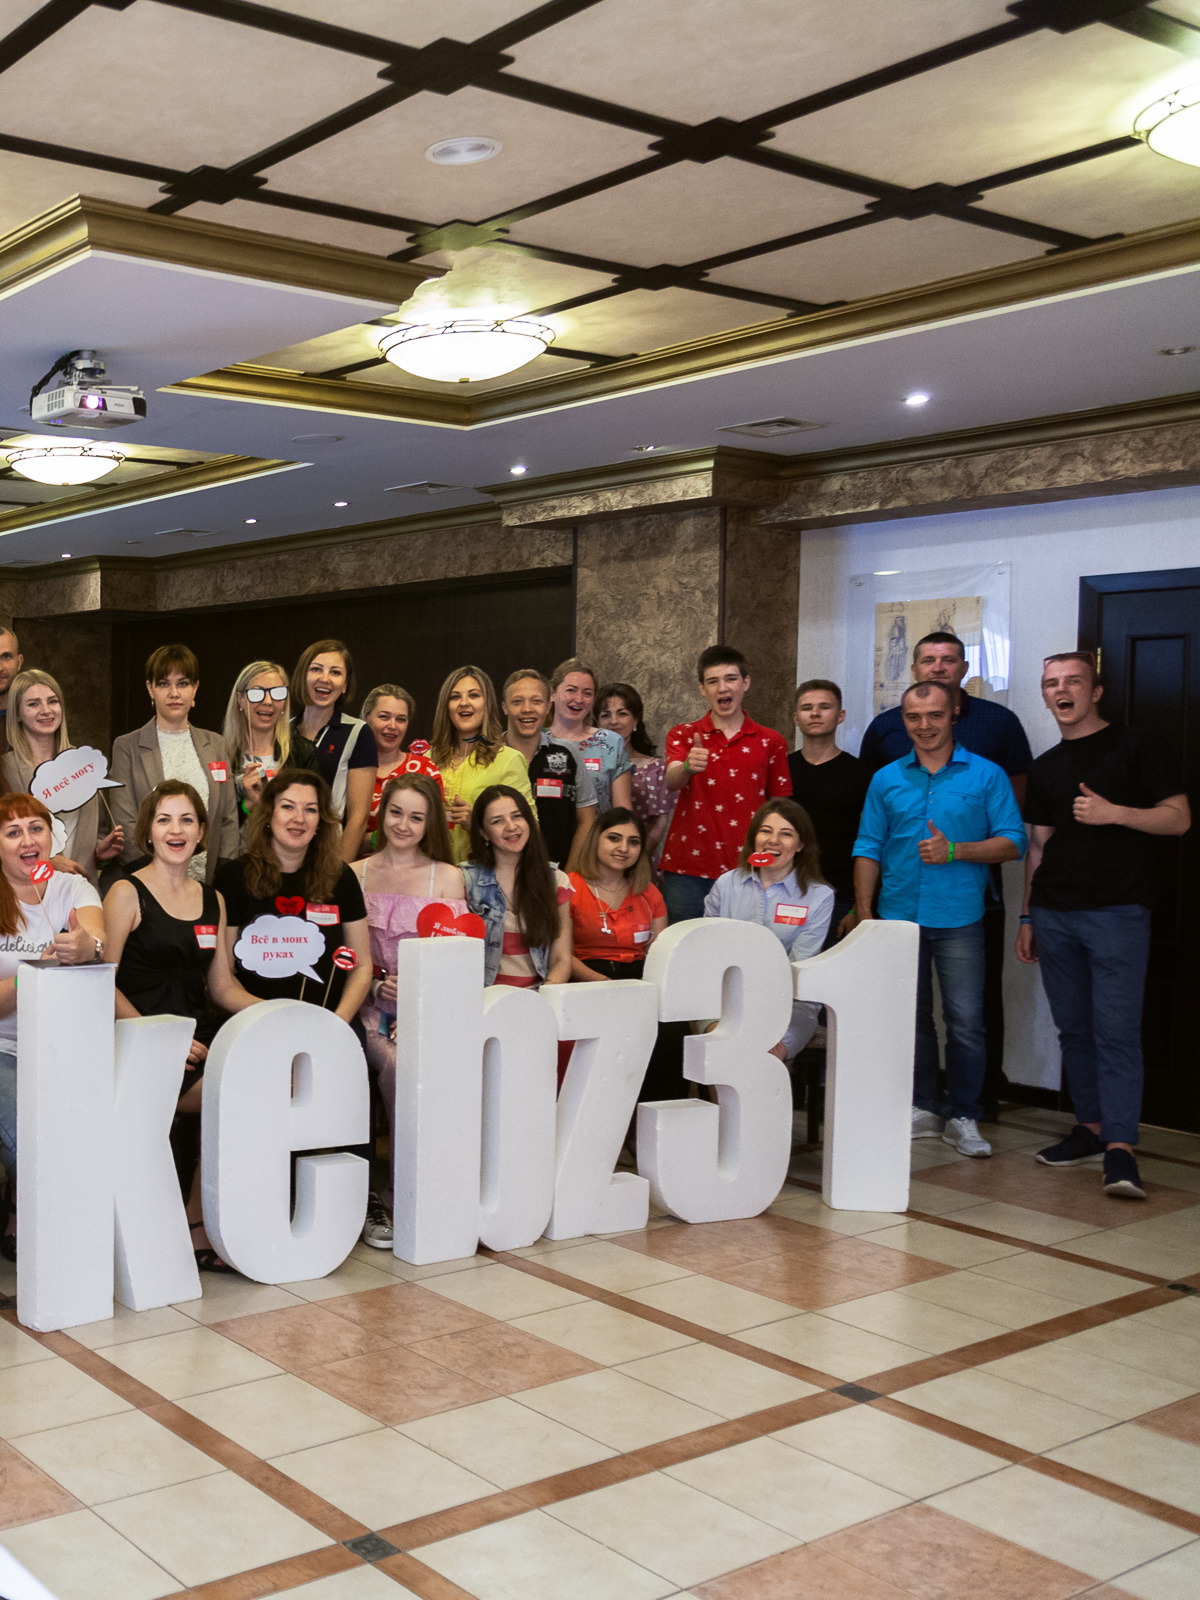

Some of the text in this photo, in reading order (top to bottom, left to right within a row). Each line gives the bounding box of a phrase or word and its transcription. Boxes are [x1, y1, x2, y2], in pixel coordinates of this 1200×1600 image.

[42, 762, 95, 799] Я всё могу
[250, 935, 269, 945] Всё
[281, 936, 309, 944] моих
[262, 951, 294, 961] руках
